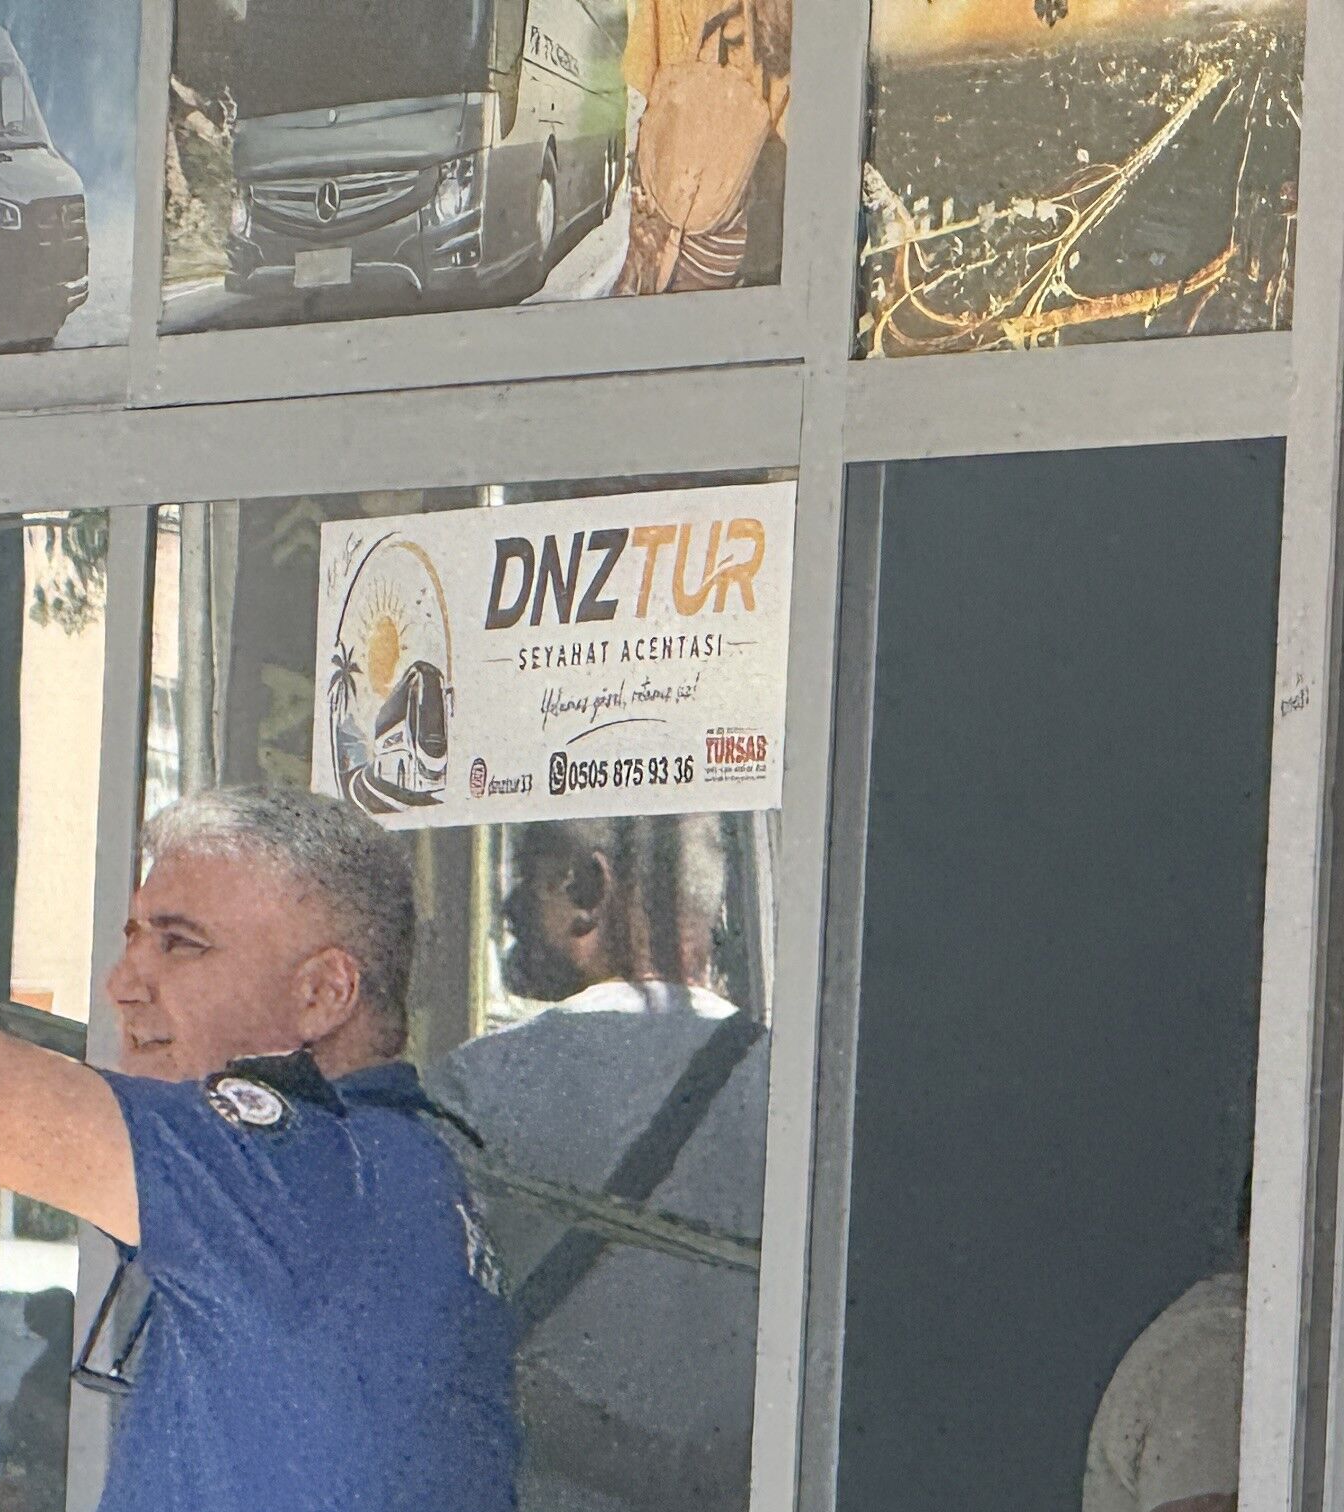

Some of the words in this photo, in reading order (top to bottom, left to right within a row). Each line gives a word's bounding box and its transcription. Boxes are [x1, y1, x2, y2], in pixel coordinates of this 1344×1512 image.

[518, 641, 609, 670] SEYAHAT
[569, 759, 608, 791] 0505
[613, 758, 644, 788] 875
[648, 757, 668, 785] 93
[673, 754, 694, 784] 36
